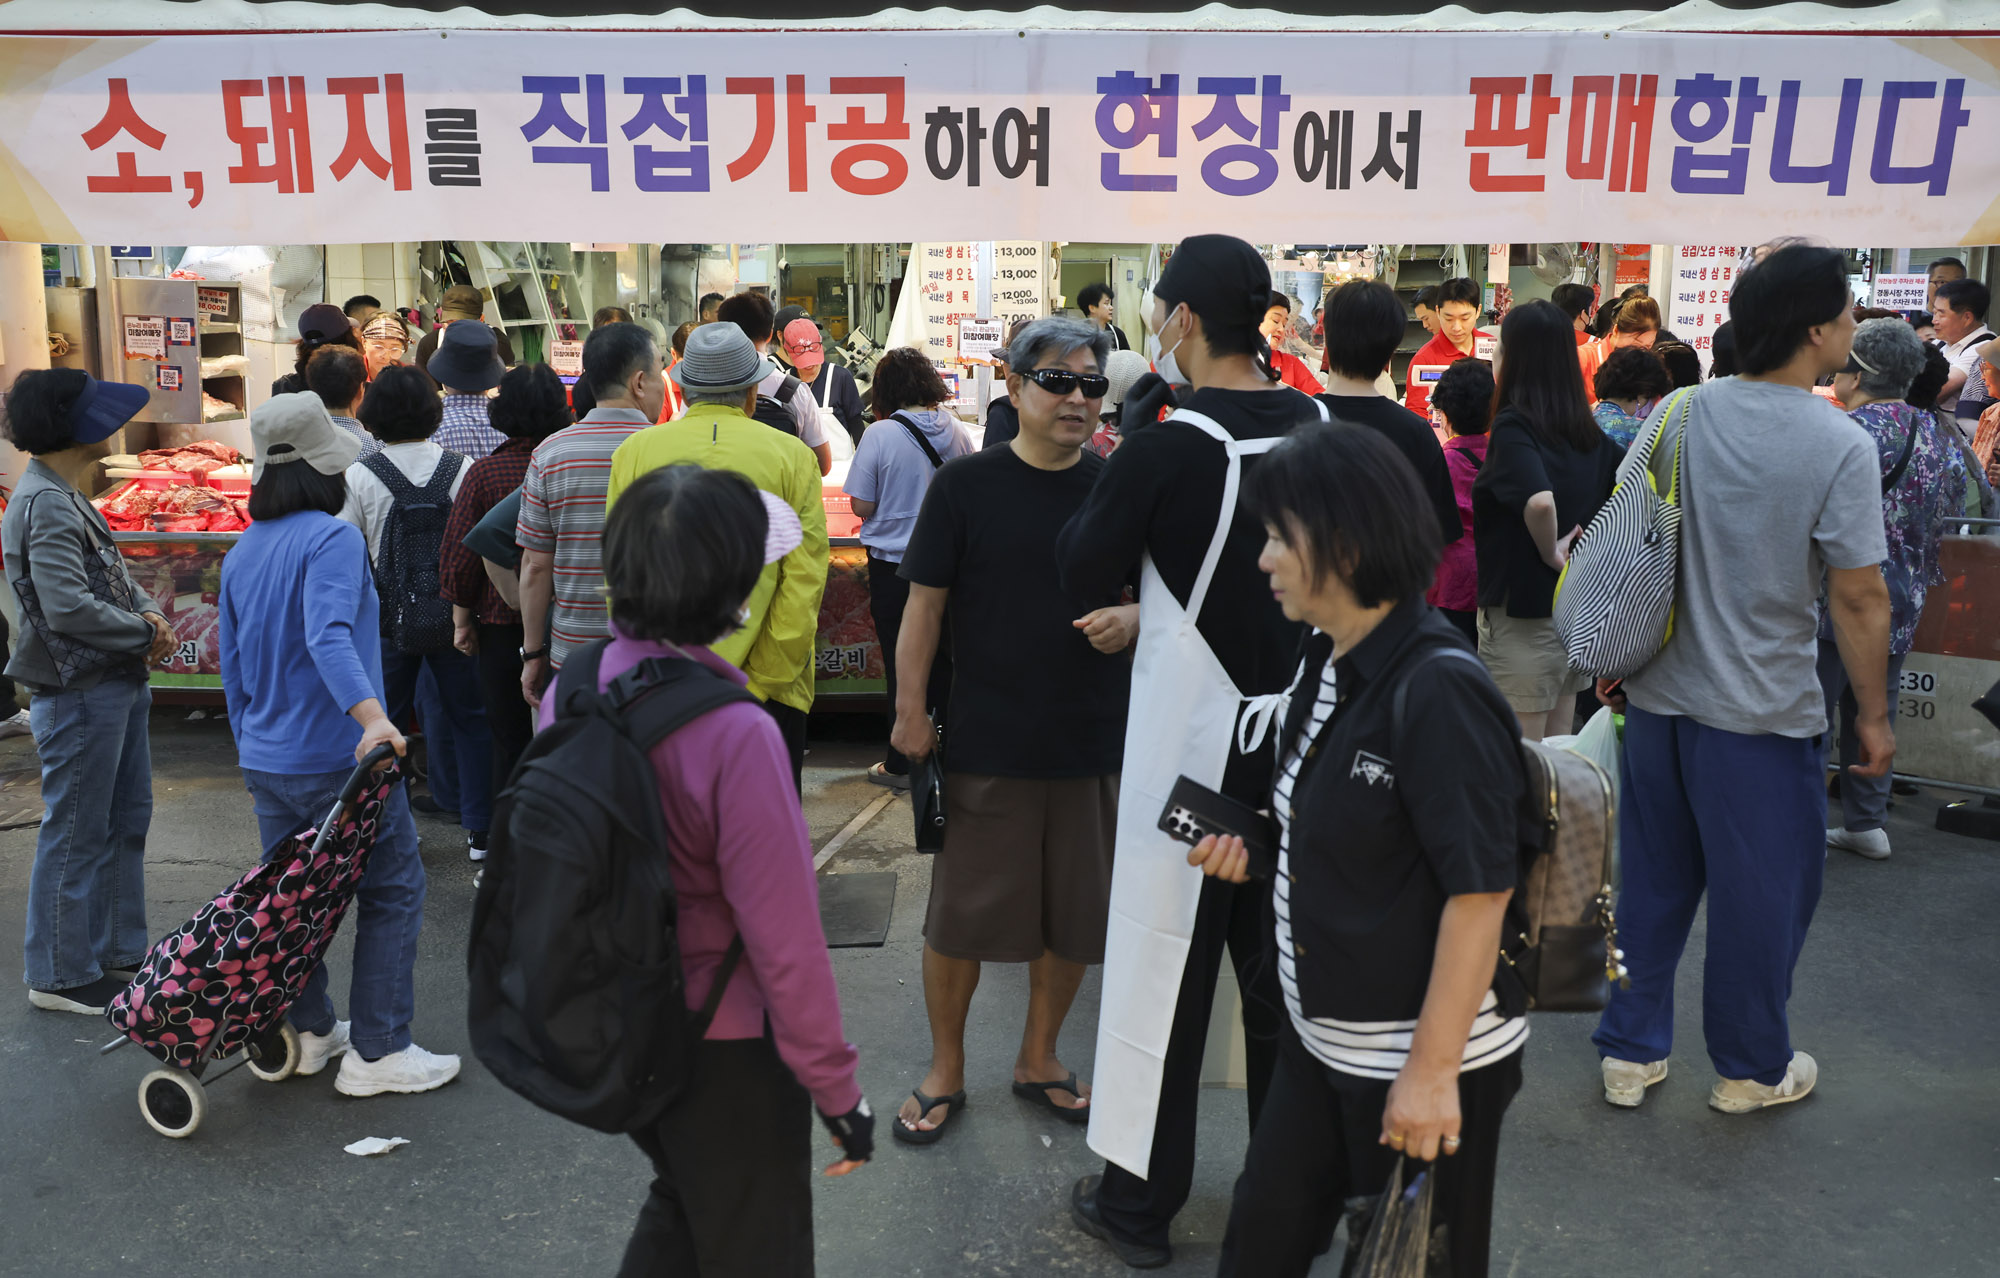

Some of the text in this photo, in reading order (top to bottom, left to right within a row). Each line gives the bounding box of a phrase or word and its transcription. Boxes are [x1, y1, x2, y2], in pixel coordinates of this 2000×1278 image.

[1095, 71, 1422, 197] 현장에서
[1464, 73, 1969, 196] 판매합니다
[928, 249, 944, 257] 국내산
[1000, 248, 1036, 258] 13,000
[928, 271, 944, 280] 국내산
[1001, 270, 1037, 280] 13,000
[1680, 270, 1698, 279] 국내산
[928, 293, 944, 302] 국내산
[1002, 290, 1032, 300] 12,000
[1679, 293, 1696, 302] 국내산
[929, 316, 944, 324] 국내산
[1678, 316, 1694, 324] 국내산
[128, 328, 162, 337] 미참여매장
[964, 332, 999, 341] 미참여매장
[929, 338, 944, 346] 국내산
